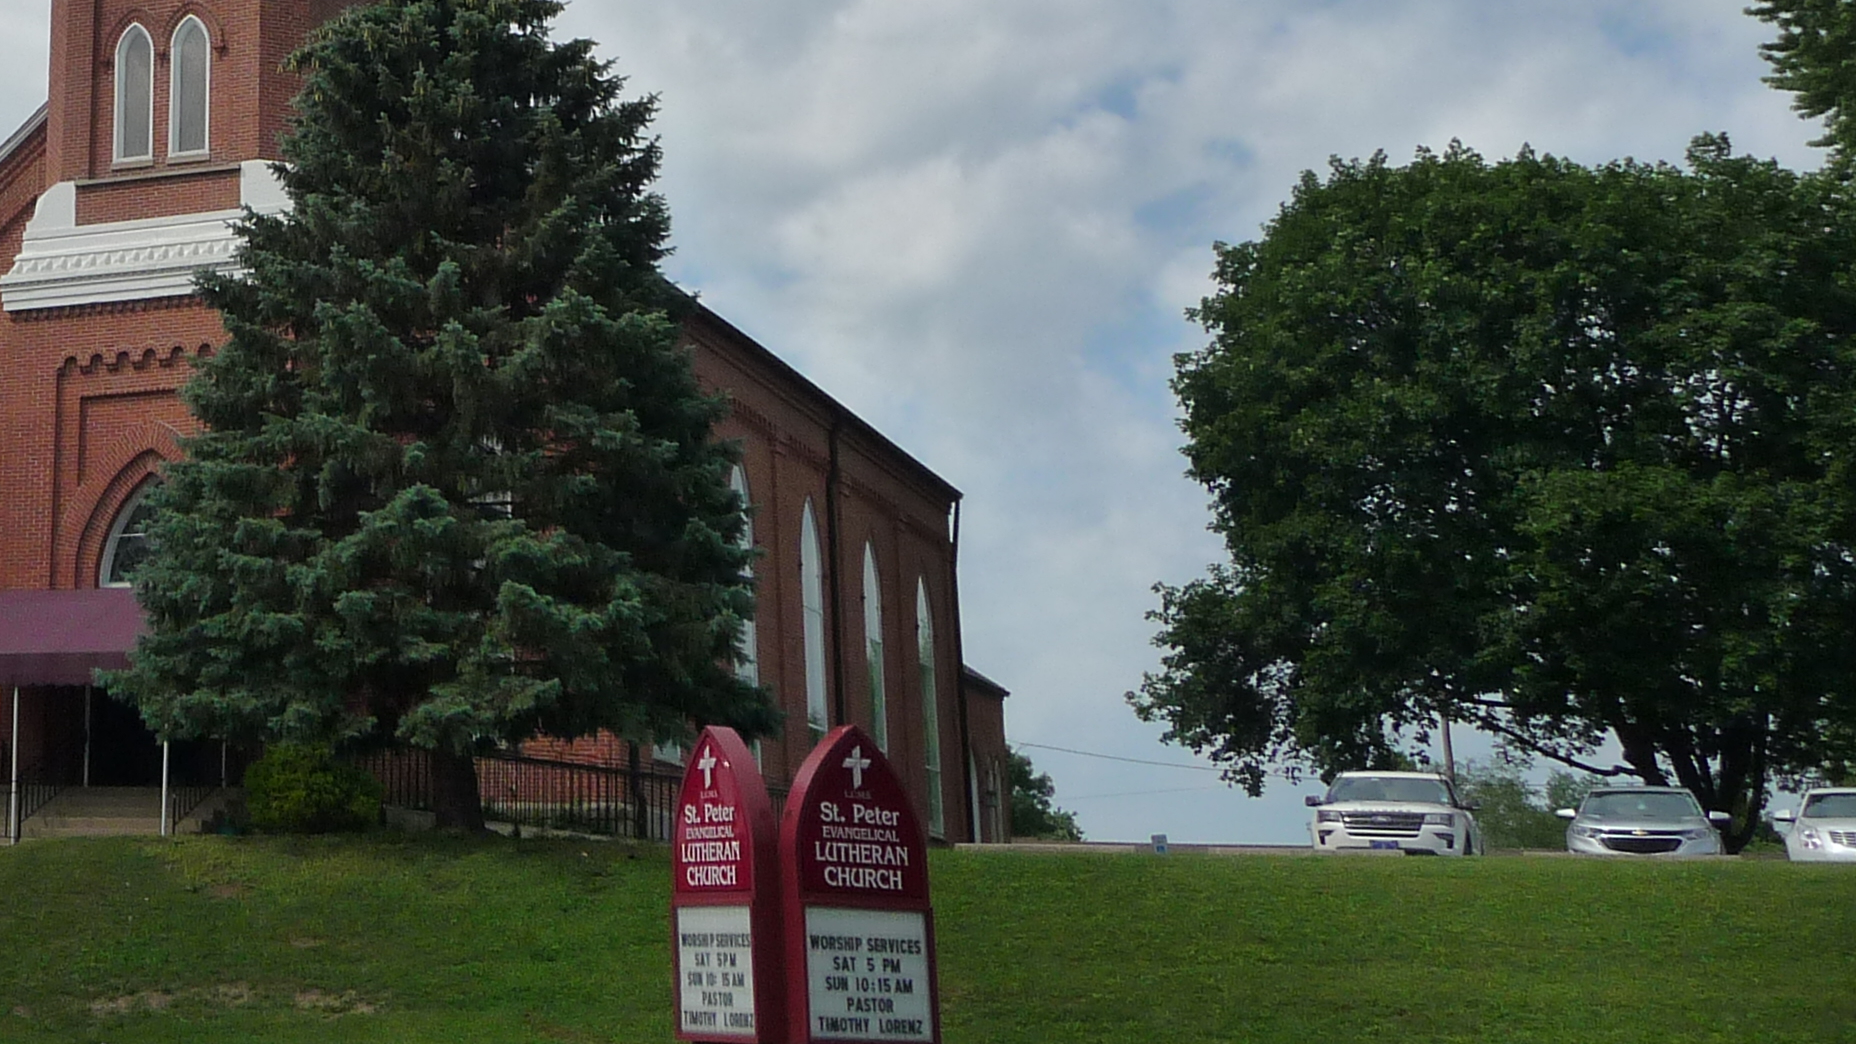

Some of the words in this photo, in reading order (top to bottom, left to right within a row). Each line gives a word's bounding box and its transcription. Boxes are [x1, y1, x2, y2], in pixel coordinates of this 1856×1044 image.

[684, 804, 700, 824] St.
[704, 804, 734, 823] Peter
[820, 801, 845, 823] St.
[853, 804, 900, 826] Peter
[686, 825, 734, 840] EVANGELICAL
[822, 825, 900, 843] EVANGELICAL
[681, 840, 740, 863] LUTHERAN
[815, 841, 909, 866] LUTHERAN
[686, 864, 737, 886] CHURCH
[824, 866, 903, 890] CHURCH
[681, 933, 714, 947] WORSHIP
[809, 935, 863, 951] WORSHIP
[866, 938, 922, 954] SERVICES
[694, 952, 710, 967] SAT
[833, 956, 856, 972] SAT
[866, 958, 875, 972] 5
[882, 958, 901, 973] PM
[687, 972, 703, 986] SUN
[825, 976, 849, 991] SUN
[856, 977, 892, 993] 10:15
[894, 978, 913, 993] AM
[702, 991, 734, 1007] PASTOR
[846, 997, 894, 1013] PASTOR
[684, 1011, 717, 1026] TIMOTHY
[724, 1012, 754, 1028] LORENZ
[818, 1016, 870, 1033] TIMOTHY
[879, 1018, 923, 1035] LORENZ
